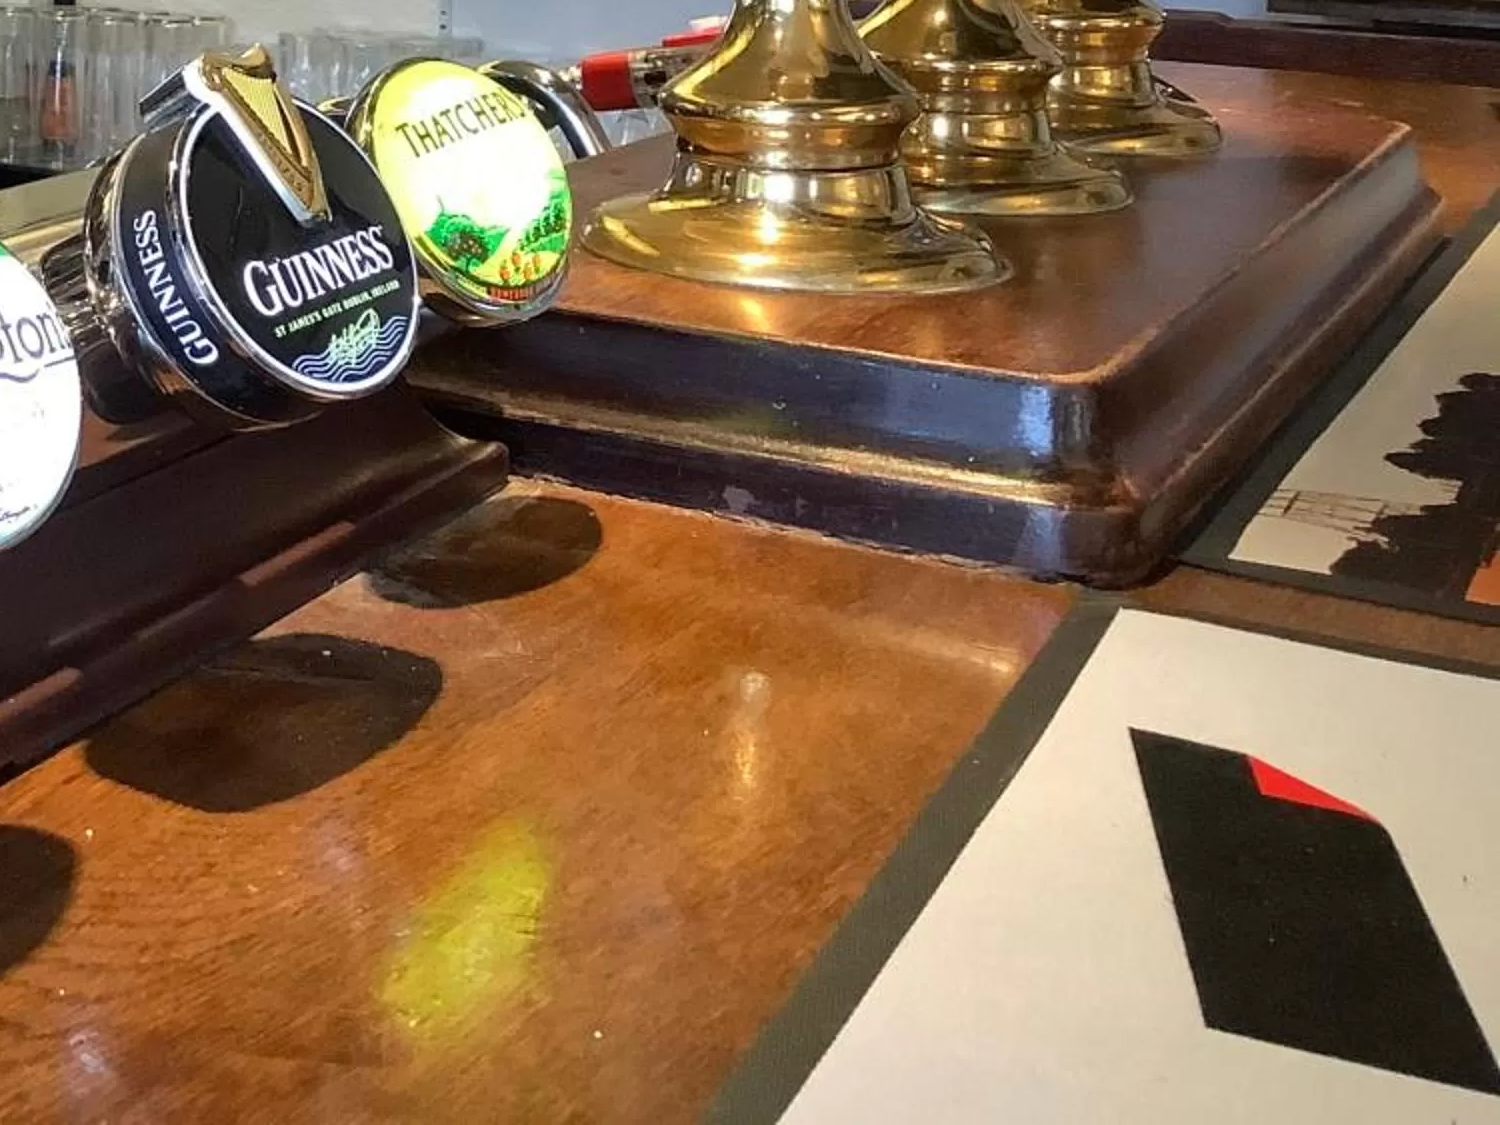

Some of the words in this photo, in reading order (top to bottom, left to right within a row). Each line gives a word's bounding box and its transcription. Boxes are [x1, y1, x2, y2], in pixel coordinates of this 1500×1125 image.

[394, 89, 530, 158] THATCHERS
[134, 210, 219, 365] GUINNESS
[243, 227, 393, 316] GUINNESS
